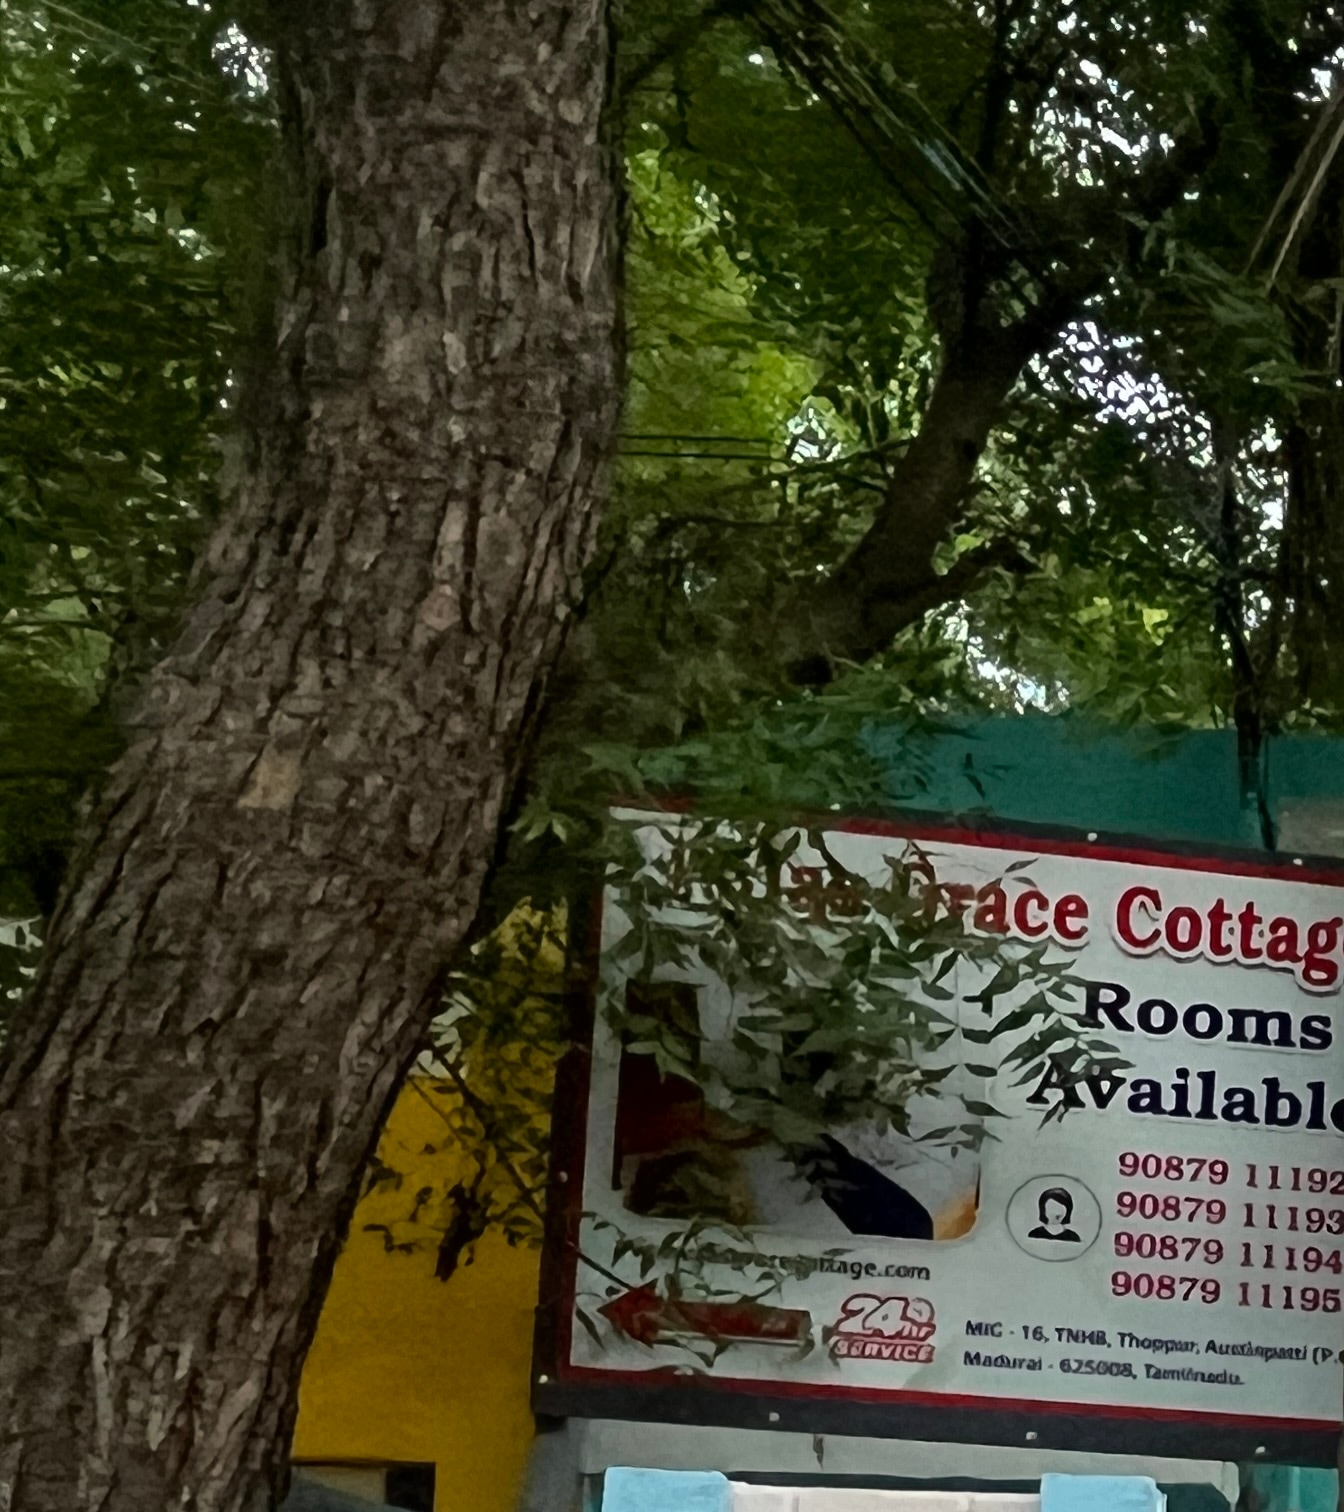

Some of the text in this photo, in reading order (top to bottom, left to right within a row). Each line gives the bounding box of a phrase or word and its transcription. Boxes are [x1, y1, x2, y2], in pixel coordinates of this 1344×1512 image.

[1083, 980, 1333, 1050] Rooms
[1118, 1151, 1229, 1185] 90879
[1116, 1191, 1226, 1224] 90879
[1114, 1231, 1343, 1274] 90879 11194
[1111, 1271, 1342, 1313] 90879 11195
[963, 1351, 1042, 1371] Madurai
